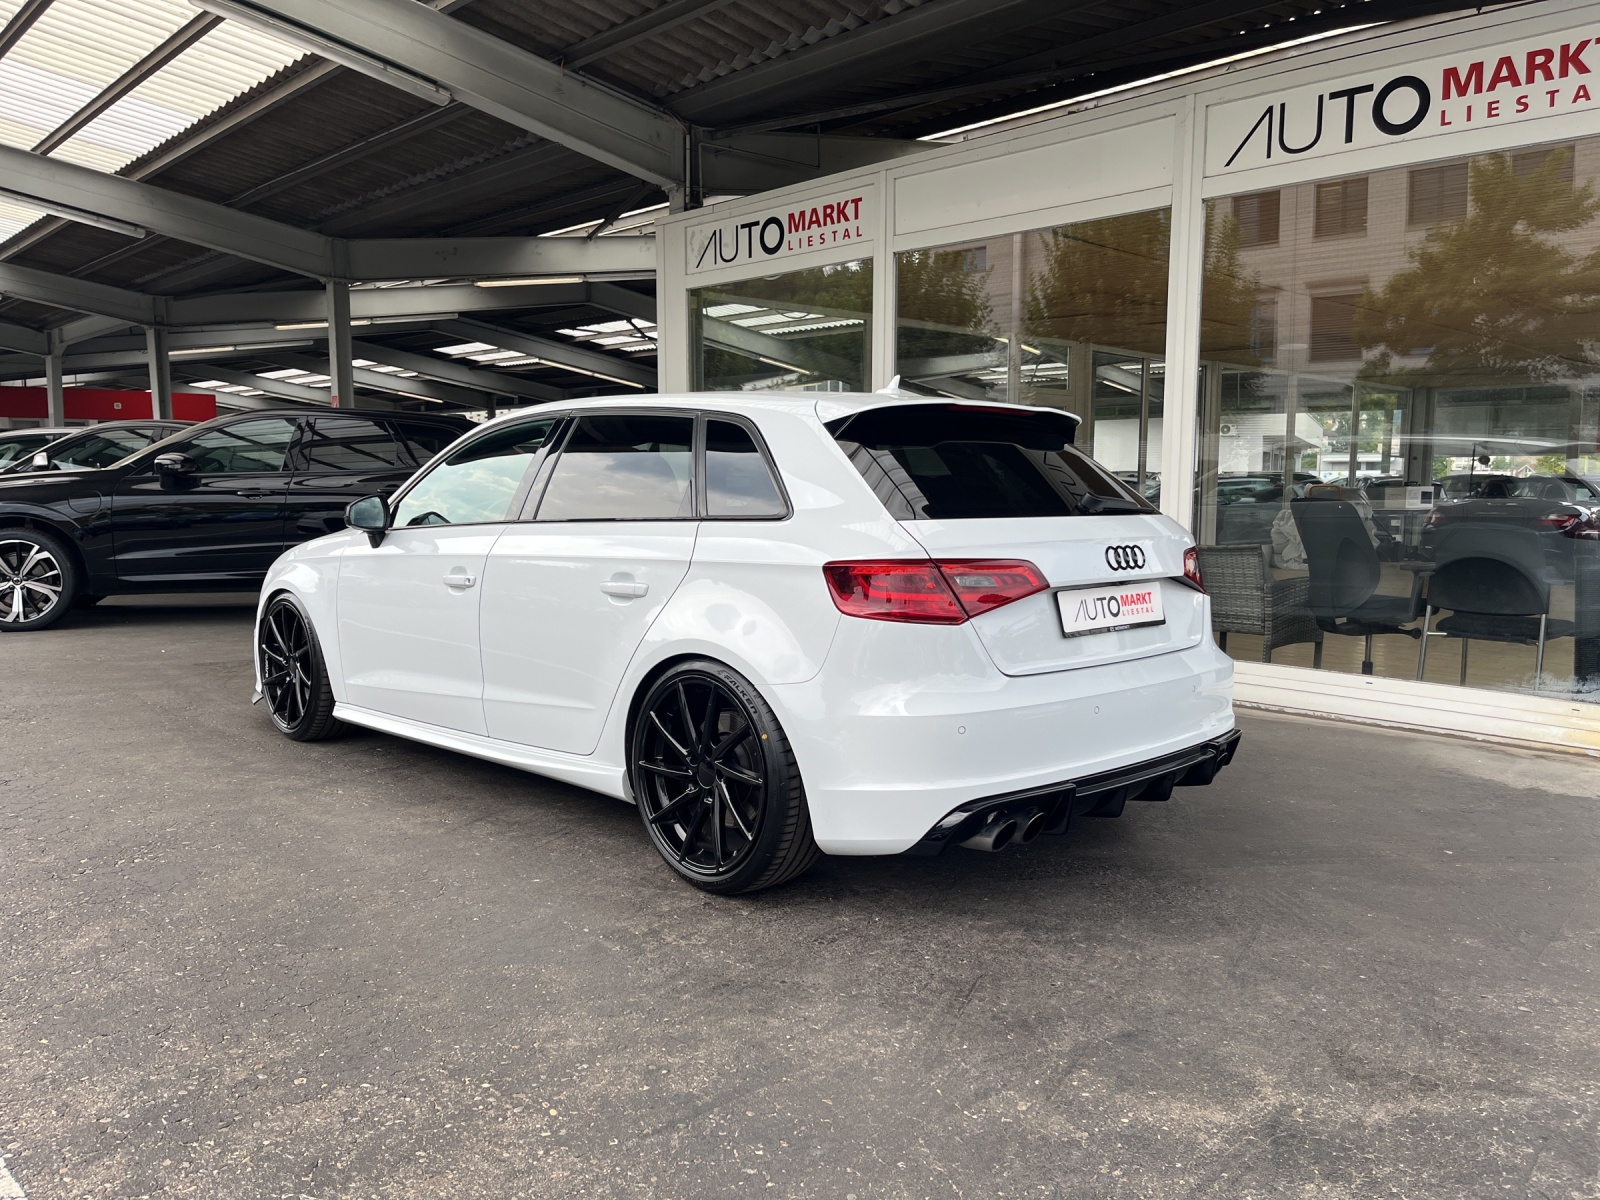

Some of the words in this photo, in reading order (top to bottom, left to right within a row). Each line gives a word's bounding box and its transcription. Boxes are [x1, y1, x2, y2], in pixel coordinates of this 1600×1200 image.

[1224, 75, 1431, 167] AUTO
[1440, 84, 1592, 126] LIESTA
[696, 216, 785, 268] AUTO
[788, 197, 862, 234] MARKT
[788, 226, 862, 251] LIESTAL
[1075, 595, 1120, 622] AUTO
[1119, 591, 1152, 607] MARKT
[1121, 606, 1154, 616] LIESTAL
